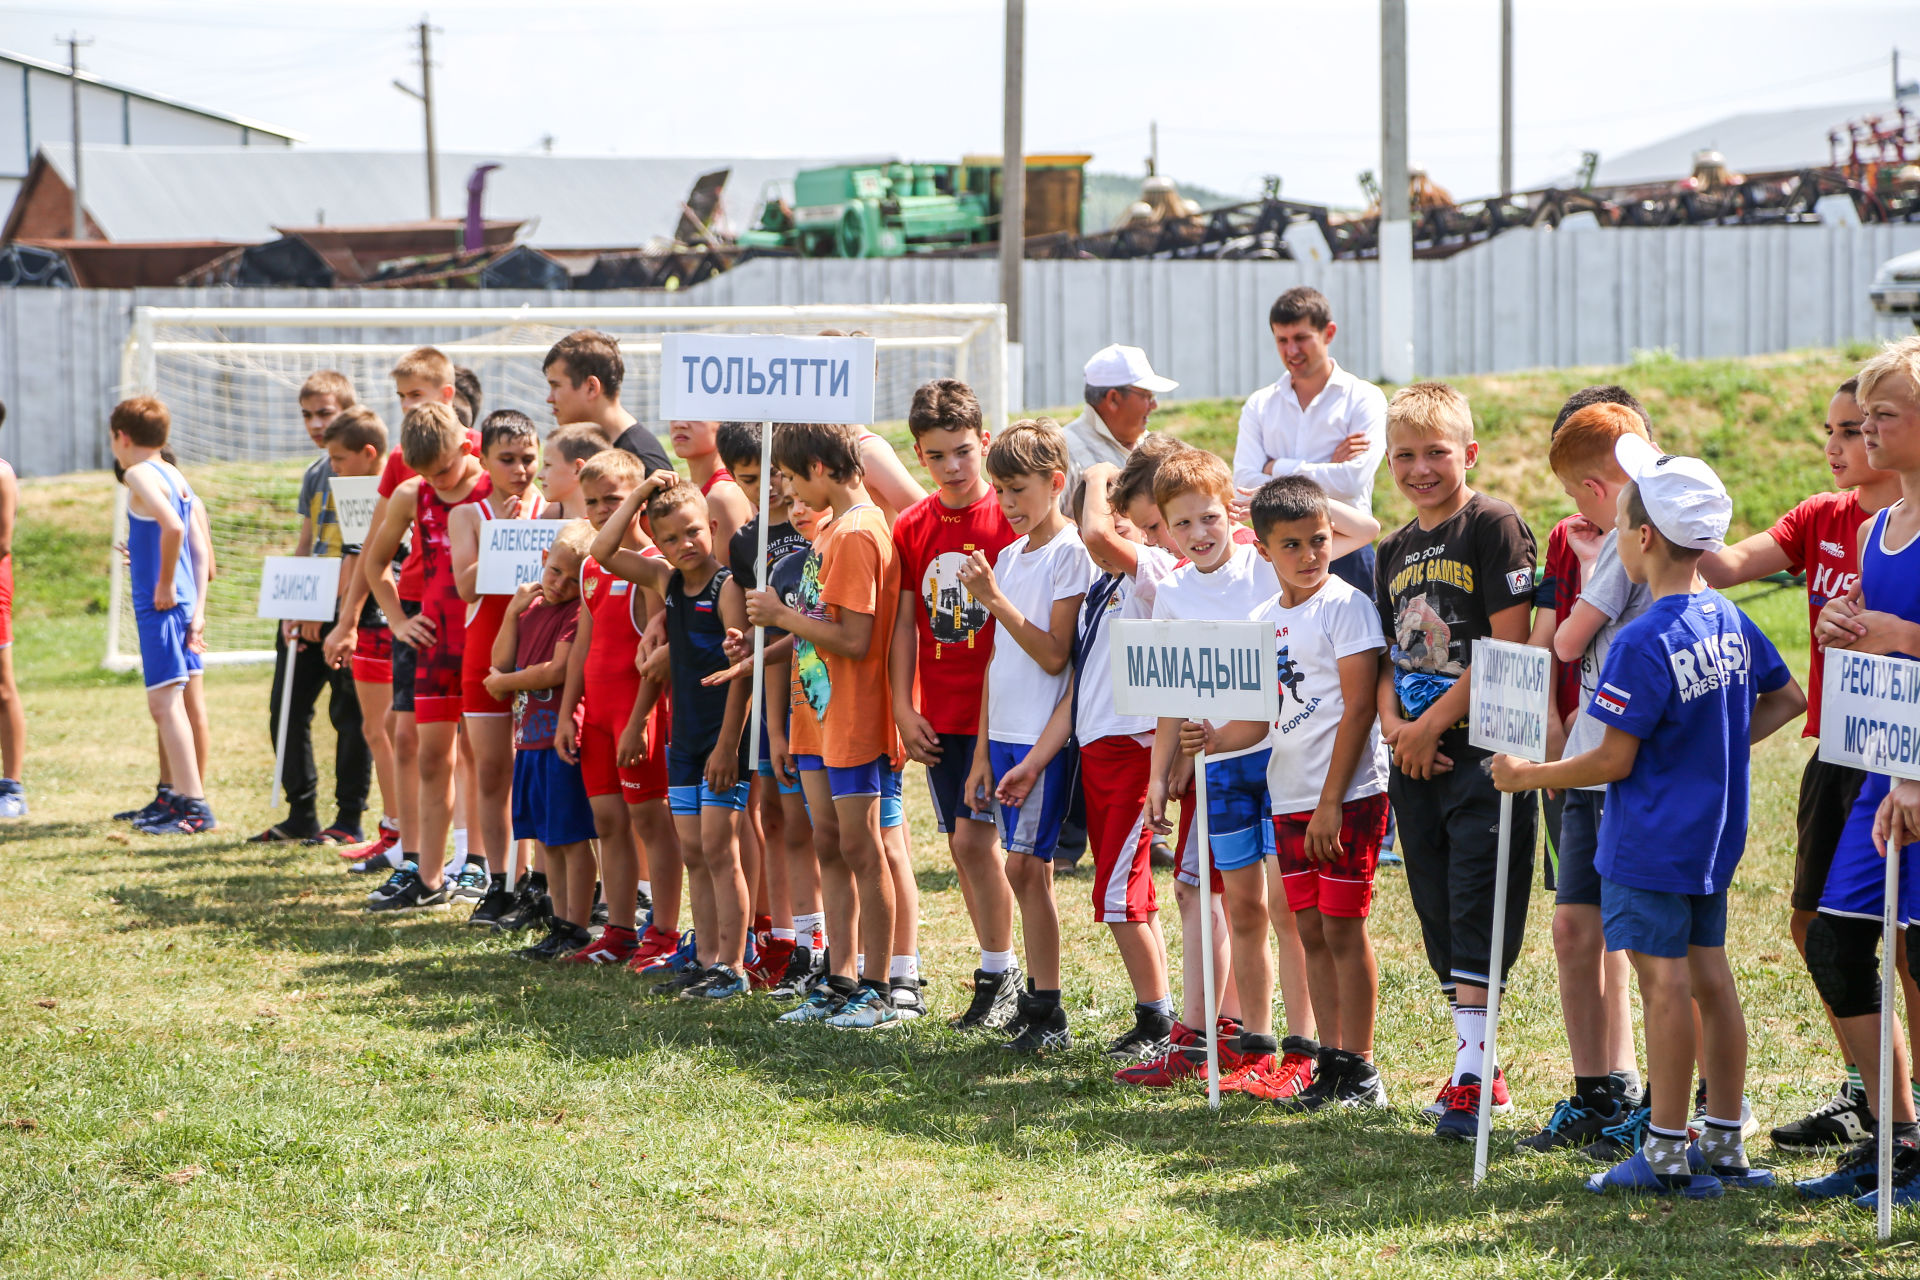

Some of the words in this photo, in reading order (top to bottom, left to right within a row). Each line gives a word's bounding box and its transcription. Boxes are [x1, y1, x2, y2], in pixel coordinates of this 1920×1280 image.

[682, 356, 849, 397] ТОЛЬЯТТИ
[941, 515, 961, 523] NYC
[774, 547, 790, 557] MMA
[783, 534, 805, 543] CLUB
[1404, 552, 1421, 566] RIO
[1421, 544, 1446, 560] 2016
[272, 574, 321, 601] ЗАИНСК
[1427, 558, 1475, 593] GAMES
[1127, 646, 1261, 698] МАМАДЫШ
[1481, 648, 1545, 692] УДМУРТСКАЯ
[1281, 696, 1321, 735] БОРЬБА
[1480, 701, 1541, 749] РЕСПУБЛИКА
